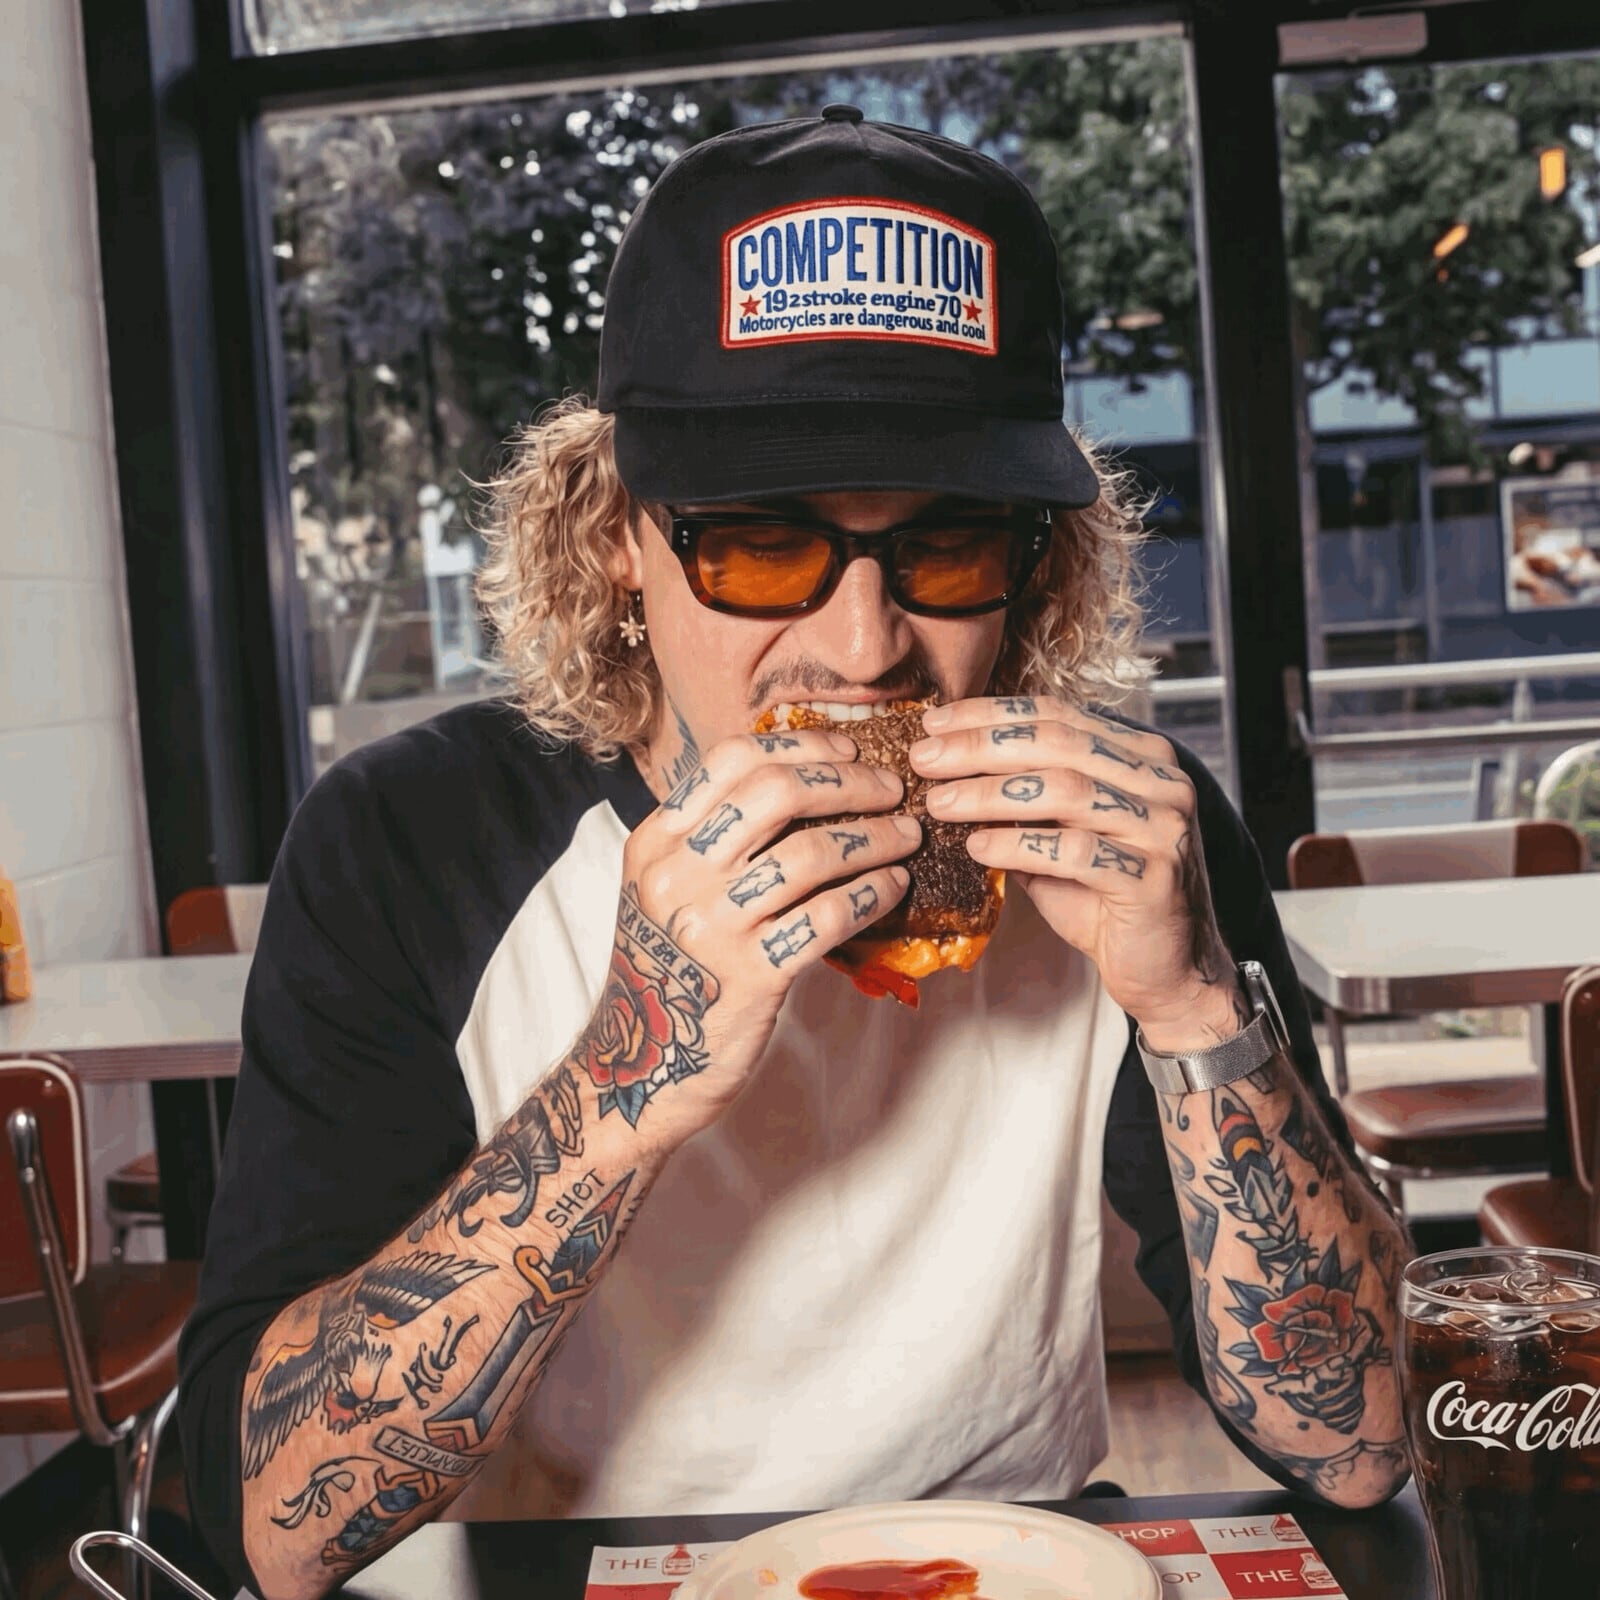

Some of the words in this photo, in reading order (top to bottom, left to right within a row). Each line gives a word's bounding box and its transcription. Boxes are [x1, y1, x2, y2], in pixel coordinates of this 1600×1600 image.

[738, 216, 983, 299] COMPETITION
[739, 310, 826, 334] Motorcycles
[830, 312, 854, 325] are
[857, 308, 933, 331] dangerous
[936, 318, 960, 335] and
[961, 324, 986, 341] cool
[545, 1168, 605, 1228] SHOT
[1117, 1527, 1176, 1541] HOP
[1212, 1526, 1268, 1539] THE
[605, 1557, 657, 1570] THE
[1161, 1571, 1202, 1584] OP
[1235, 1569, 1299, 1583] THE
